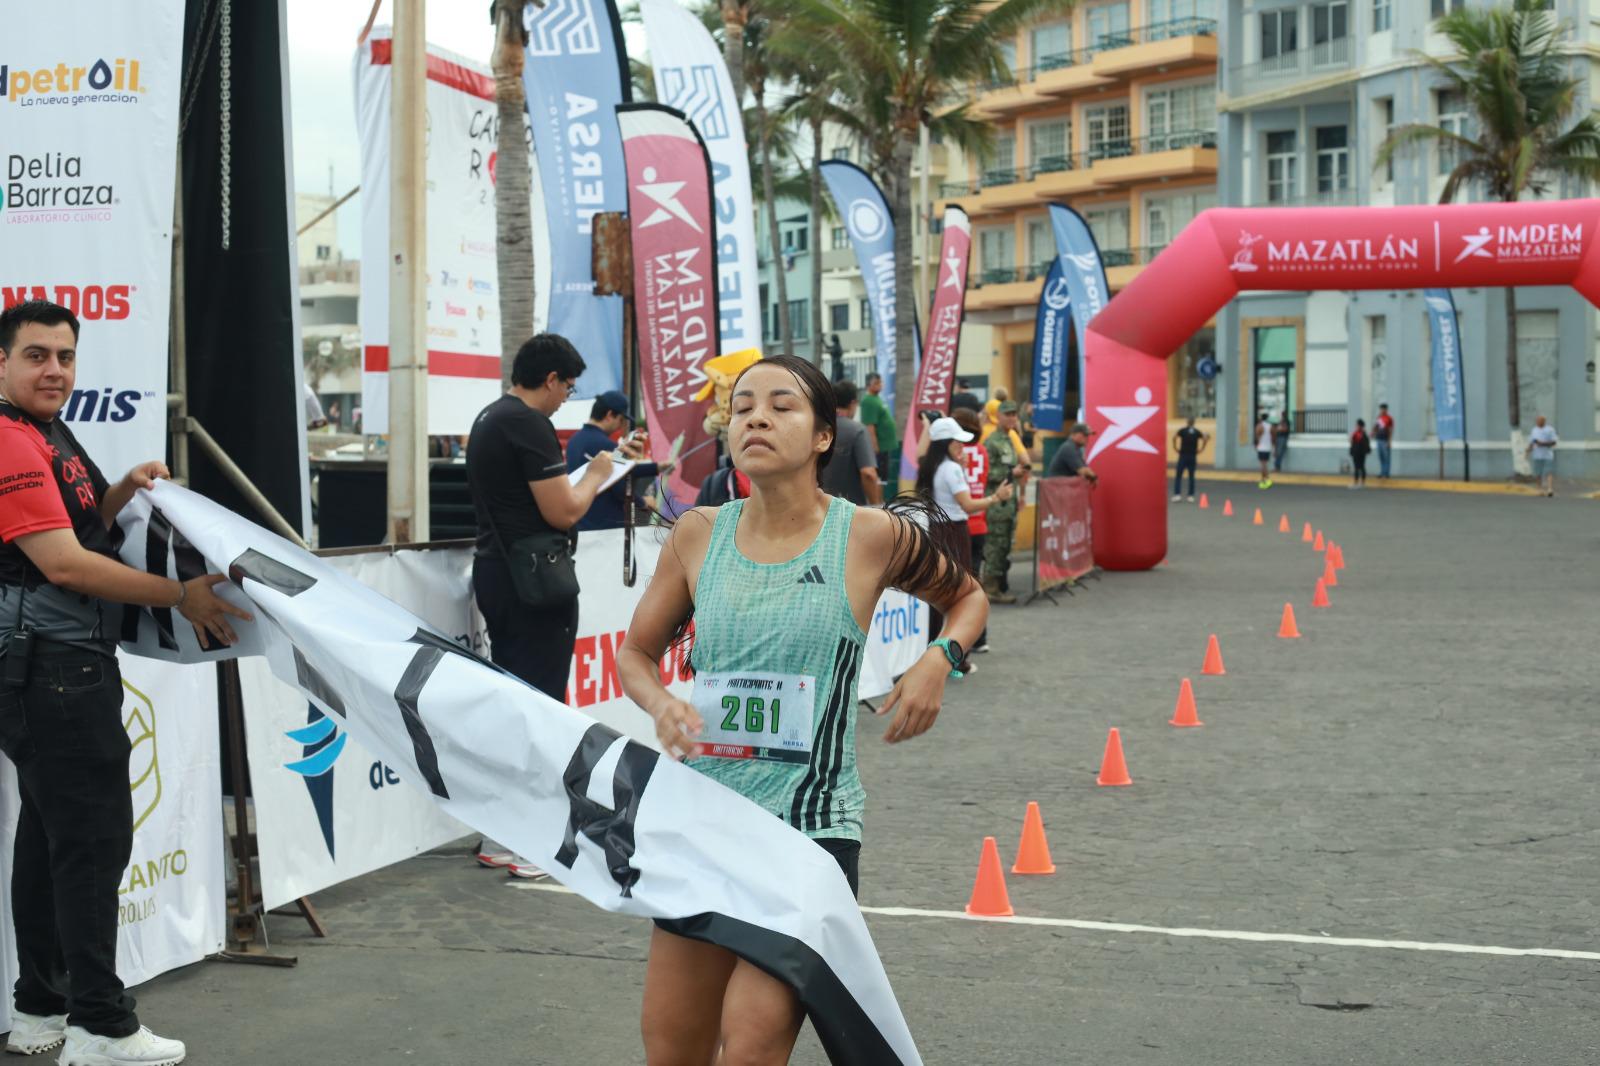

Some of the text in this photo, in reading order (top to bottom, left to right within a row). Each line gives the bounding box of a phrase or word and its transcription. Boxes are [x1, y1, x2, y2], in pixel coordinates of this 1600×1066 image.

[21, 96, 33, 107] La
[35, 96, 69, 105] nueva
[8, 152, 81, 180] Delia
[7, 182, 113, 208] Barraza
[6, 213, 70, 225] LABORATORIO
[1497, 223, 1582, 244] IMDEM
[1267, 233, 1418, 262] MAZATLÁN
[720, 695, 781, 734] 261
